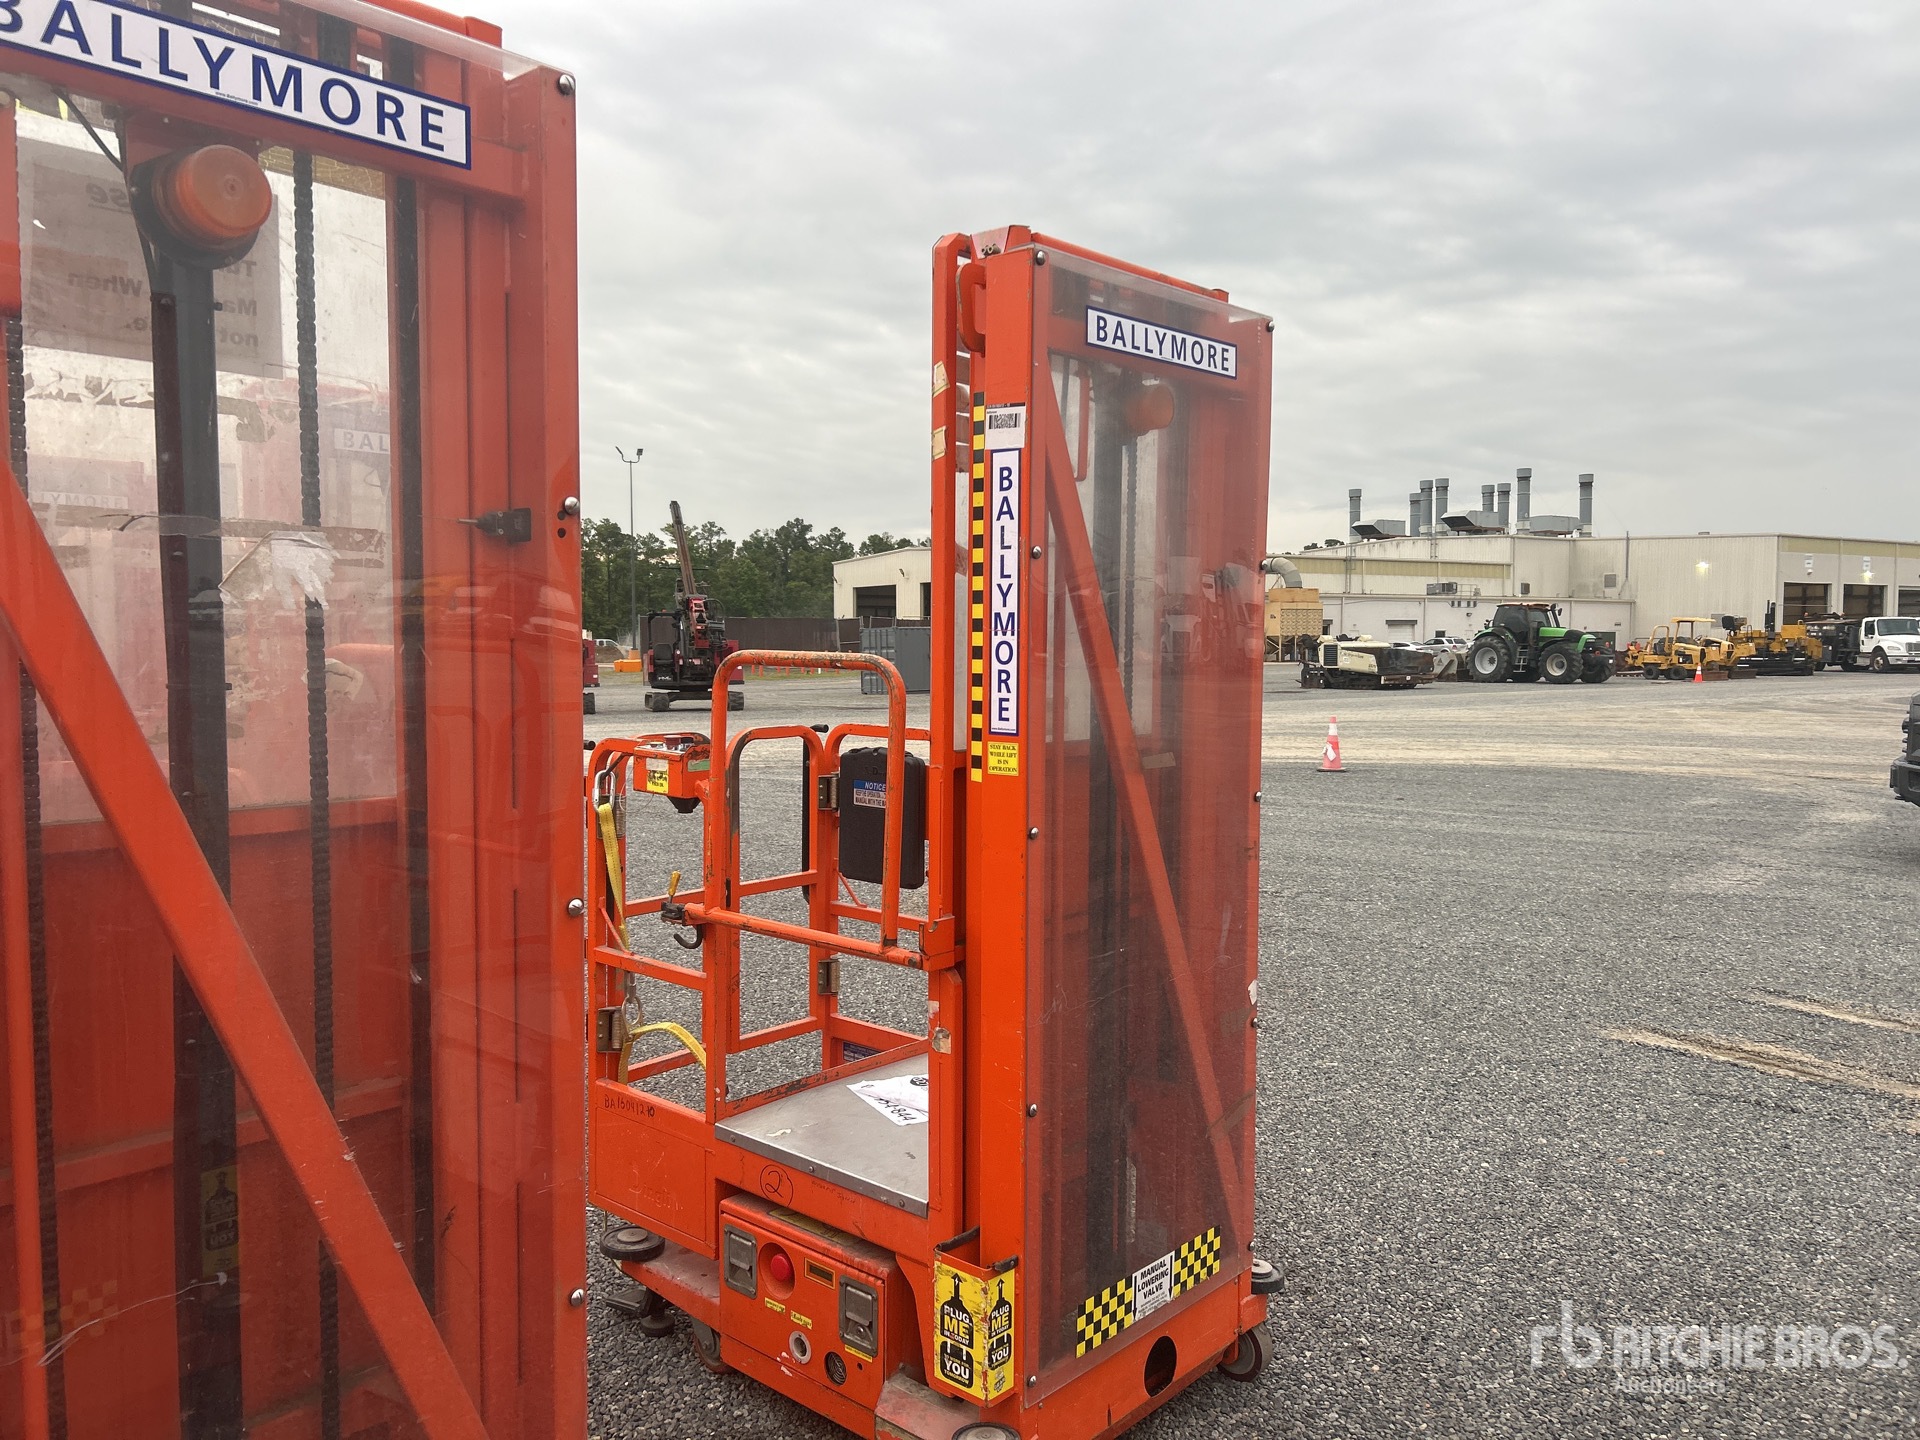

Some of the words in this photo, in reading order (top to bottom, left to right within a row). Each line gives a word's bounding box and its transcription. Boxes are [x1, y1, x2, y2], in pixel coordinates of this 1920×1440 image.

[1096, 314, 1230, 372] BALLYMORE
[343, 431, 389, 452] BAL
[993, 466, 1016, 722] BALLYMORE
[865, 782, 887, 791] NOTICE
[1137, 1268, 1169, 1293] LOWERING
[1140, 1259, 1167, 1281] MANUAL
[1143, 1282, 1164, 1300] VALVE
[991, 1304, 1010, 1320] PLUG
[991, 1312, 1010, 1332] ME
[944, 1314, 970, 1340] ME
[991, 1346, 1009, 1363] YOU
[944, 1358, 970, 1379] YOU
